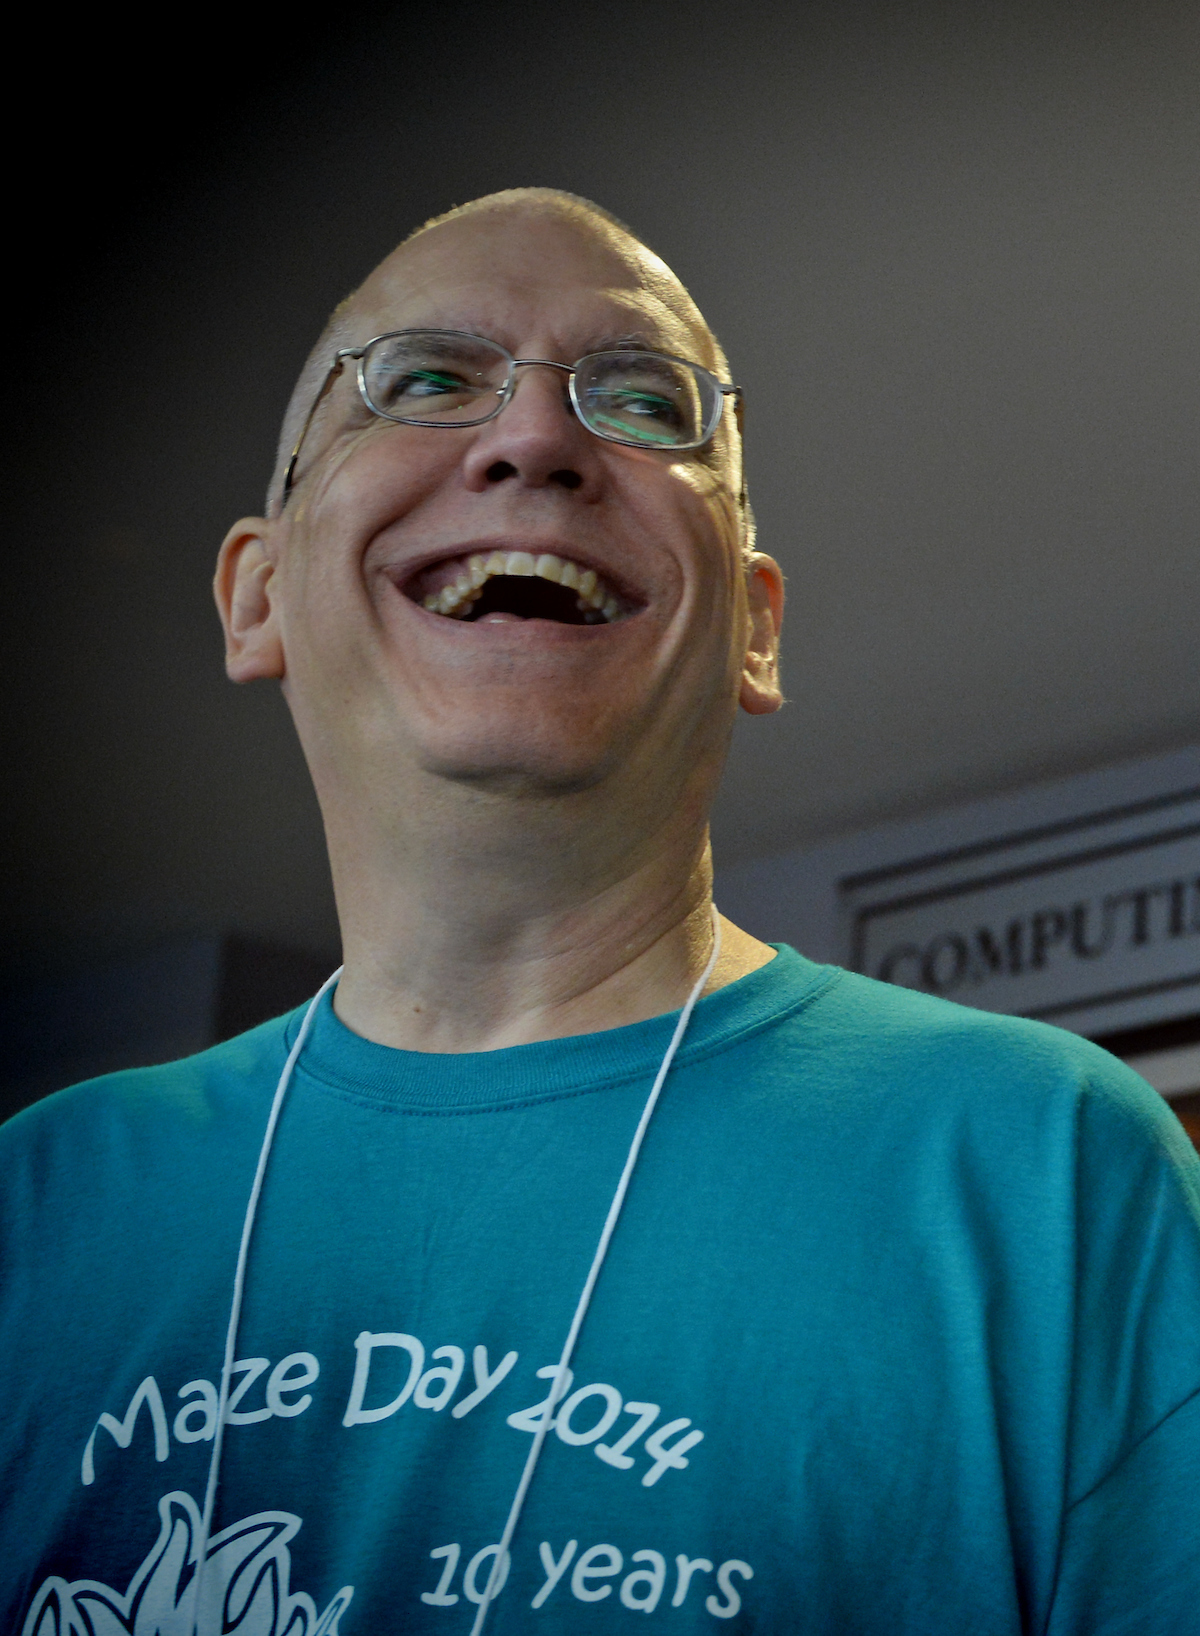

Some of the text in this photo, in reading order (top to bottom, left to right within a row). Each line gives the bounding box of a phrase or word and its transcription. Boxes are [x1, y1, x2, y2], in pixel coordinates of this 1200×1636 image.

[80, 1331, 704, 1487] Maze Day 2014
[420, 1539, 754, 1619] 10 years
